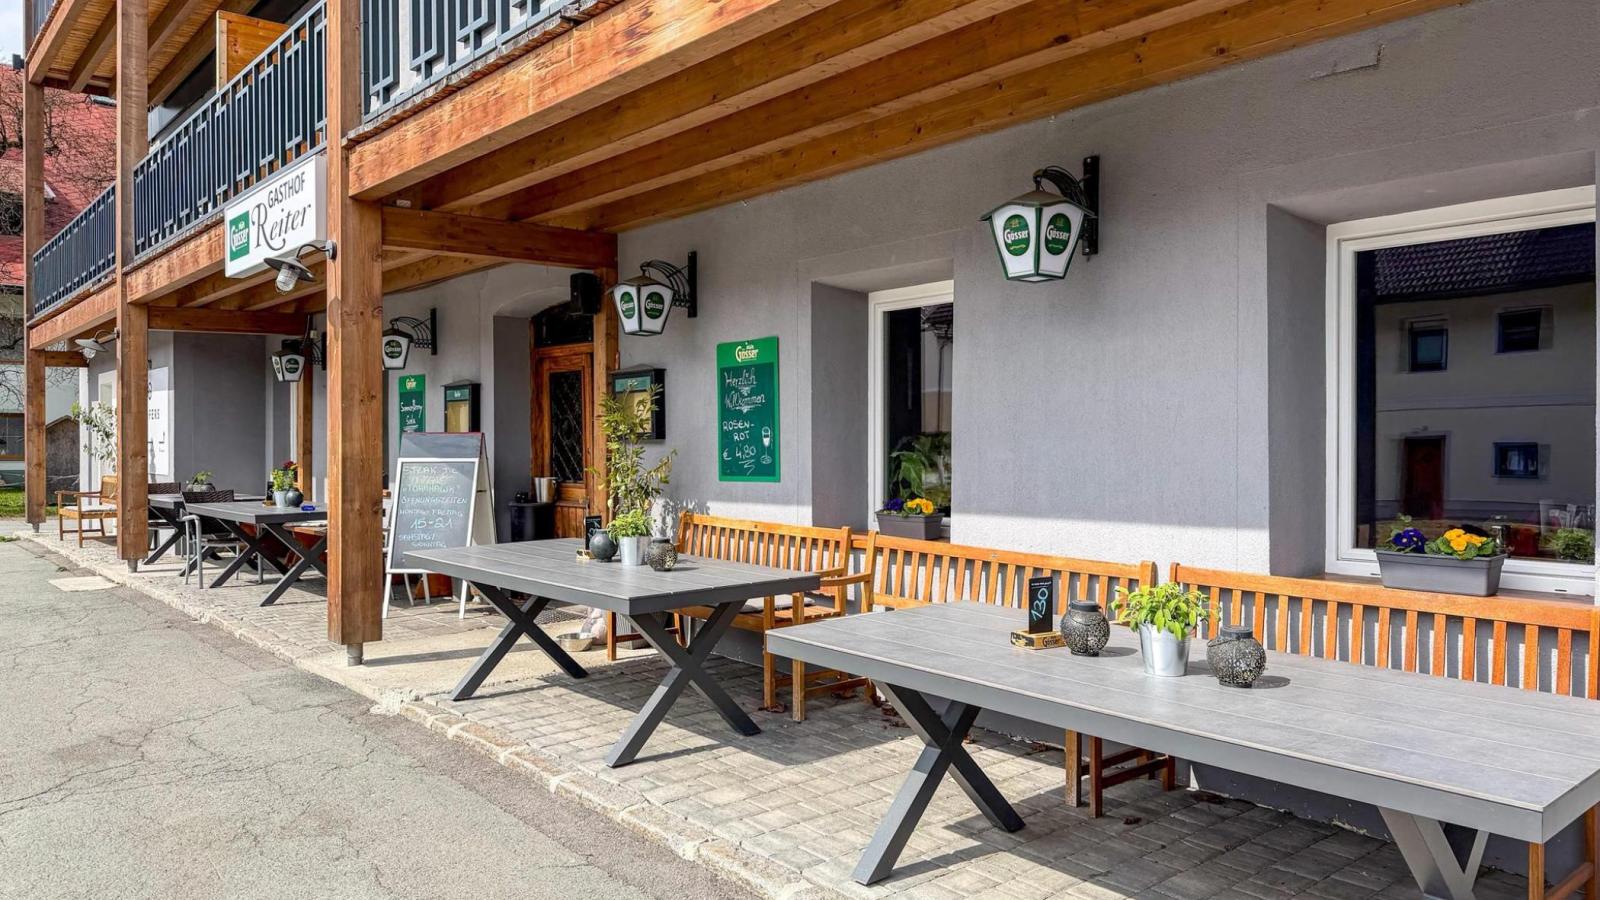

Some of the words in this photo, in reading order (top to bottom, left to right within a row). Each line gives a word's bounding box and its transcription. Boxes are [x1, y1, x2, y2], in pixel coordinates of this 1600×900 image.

[267, 171, 306, 209] GASTHOF
[251, 202, 312, 251] Reiter
[1046, 224, 1070, 241] Gösser
[1004, 229, 1028, 244] Gösser
[735, 345, 759, 362] Gösser
[722, 420, 755, 431] ROSEN-
[733, 430, 750, 442] ROT
[722, 448, 733, 461] €
[735, 444, 757, 460] 4,80
[1031, 588, 1049, 621] 130
